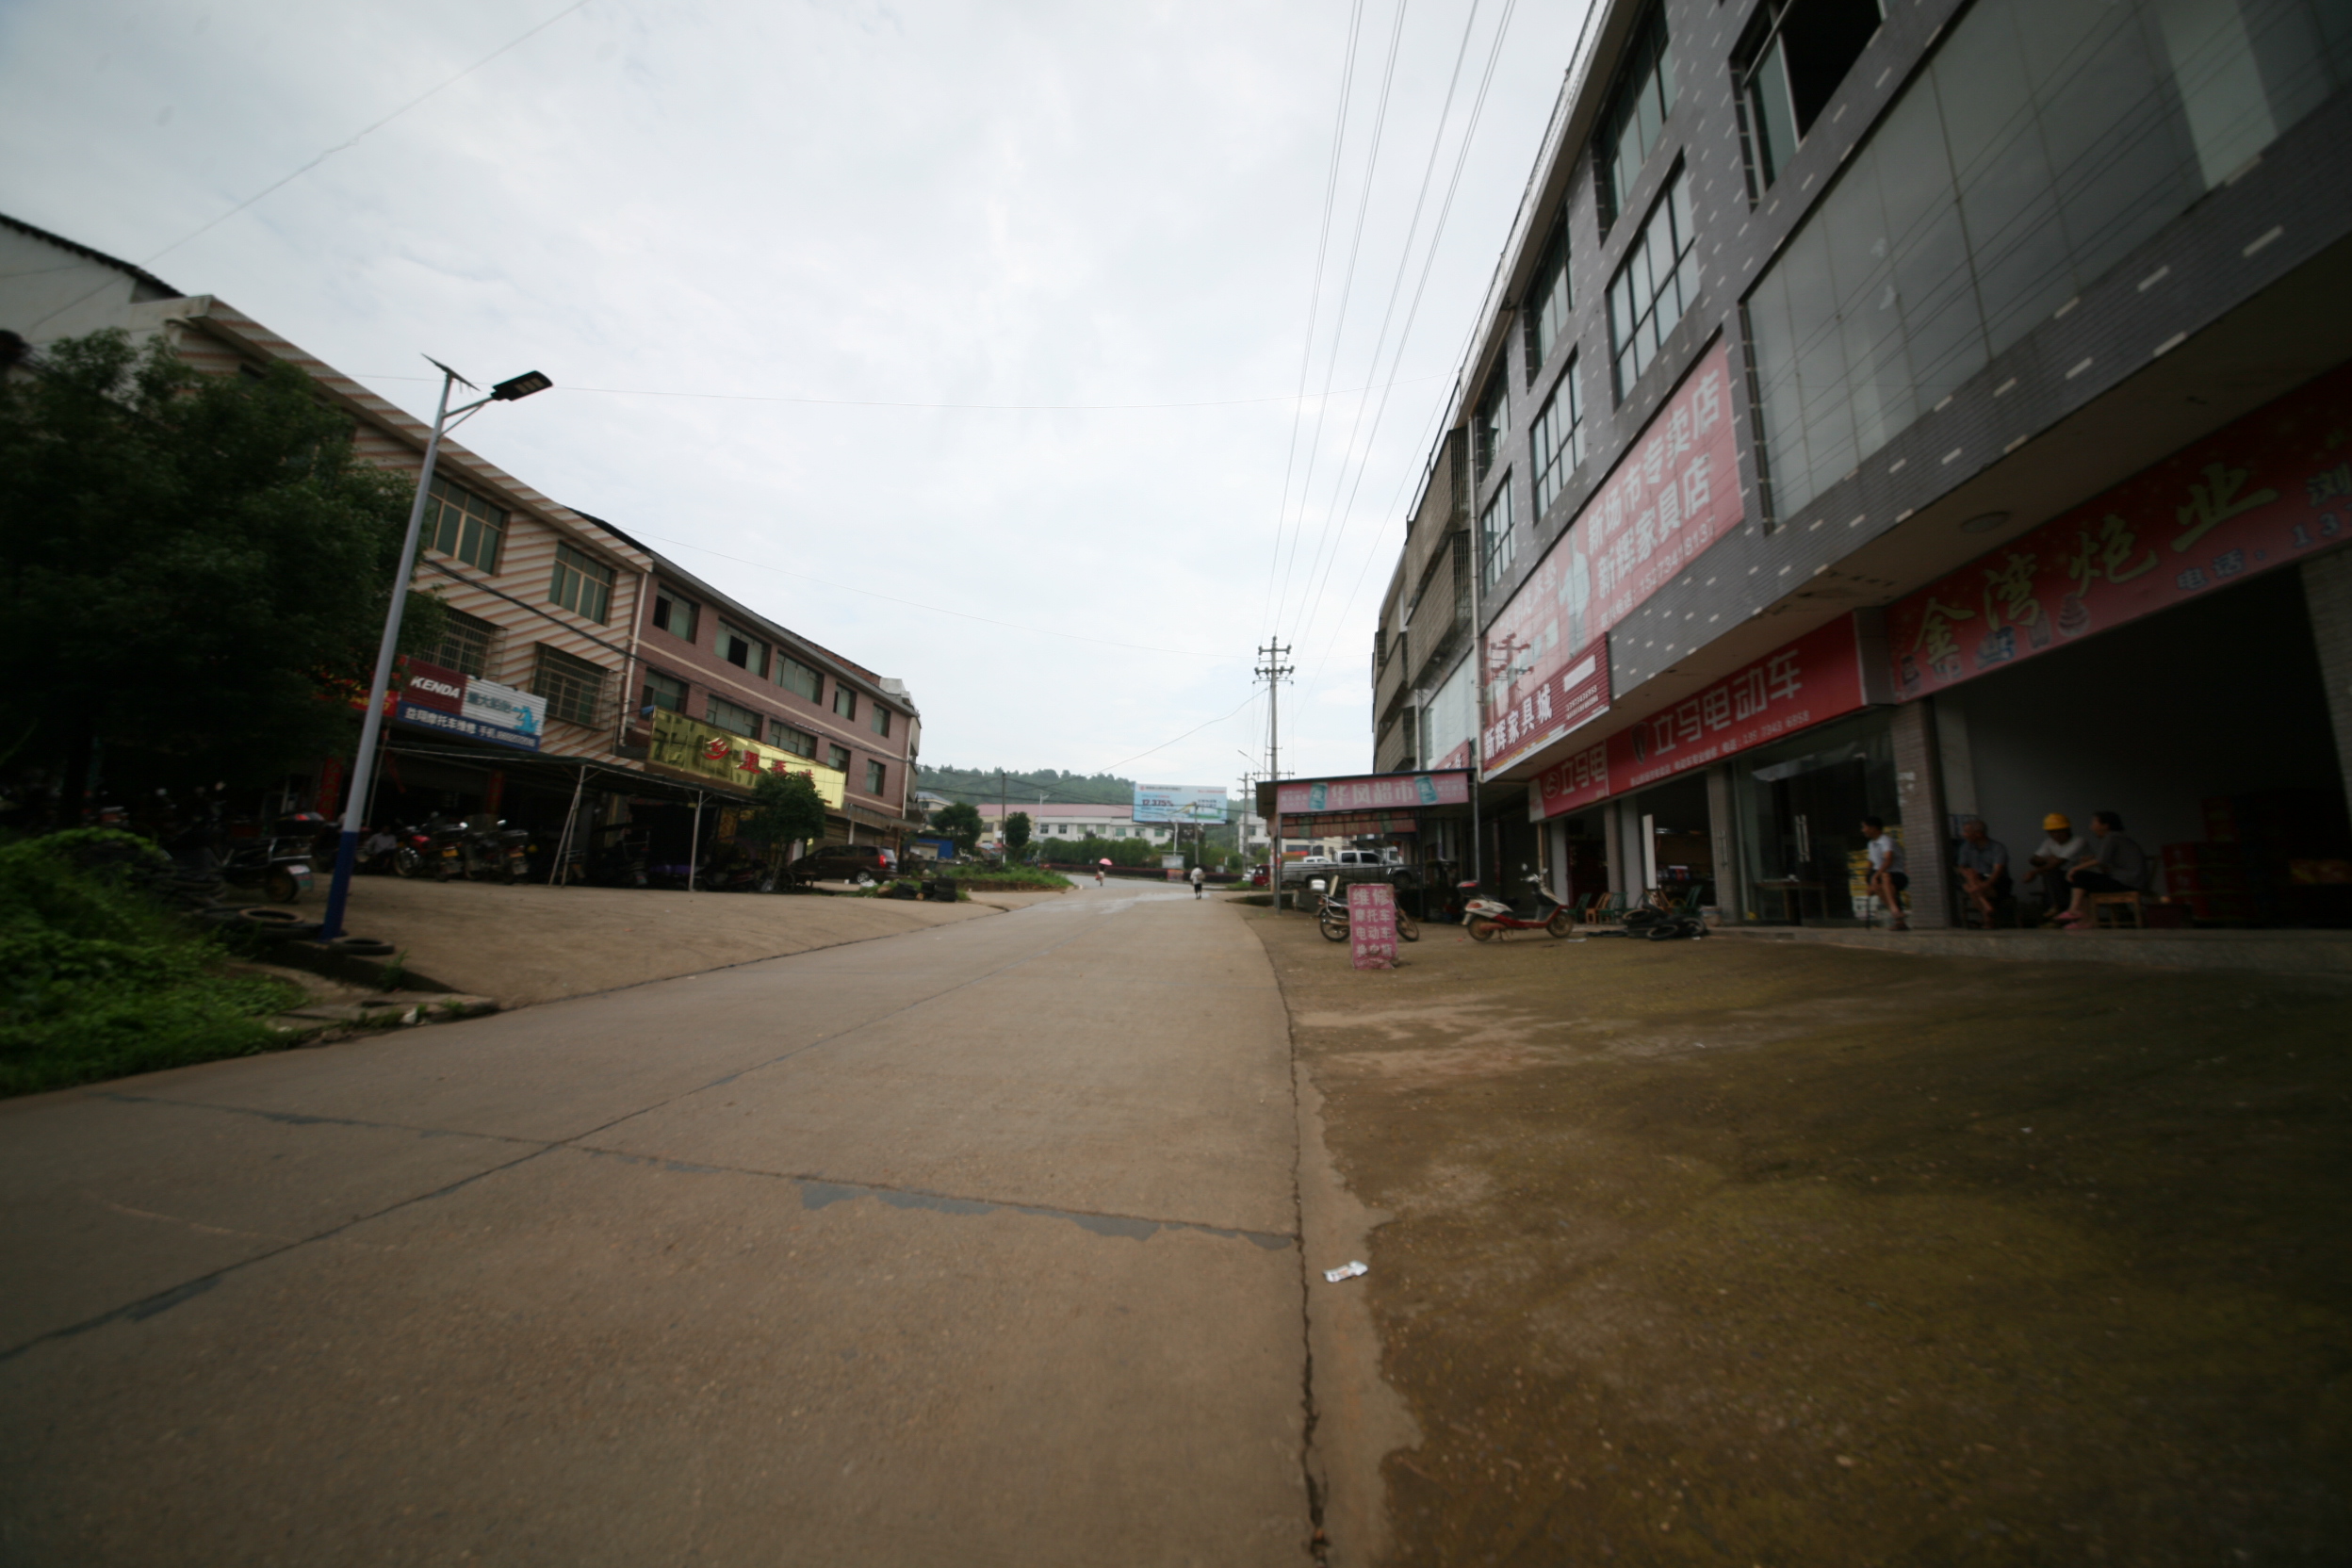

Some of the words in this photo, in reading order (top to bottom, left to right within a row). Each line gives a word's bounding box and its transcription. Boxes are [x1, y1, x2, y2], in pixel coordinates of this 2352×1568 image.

[1588, 368, 1720, 556] 新场市专卖店
[1598, 451, 1711, 599] 新辉家具店
[2292, 502, 2352, 547] 13
[1912, 462, 2279, 665] 金湾炮业
[410, 676, 461, 698] KENDA
[1654, 649, 1803, 756] 立马电动车
[1484, 683, 1553, 760] 新辉家具城
[1353, 888, 1390, 906] 维修
[1355, 908, 1391, 923] 摩托车
[1357, 926, 1392, 940] 电动车
